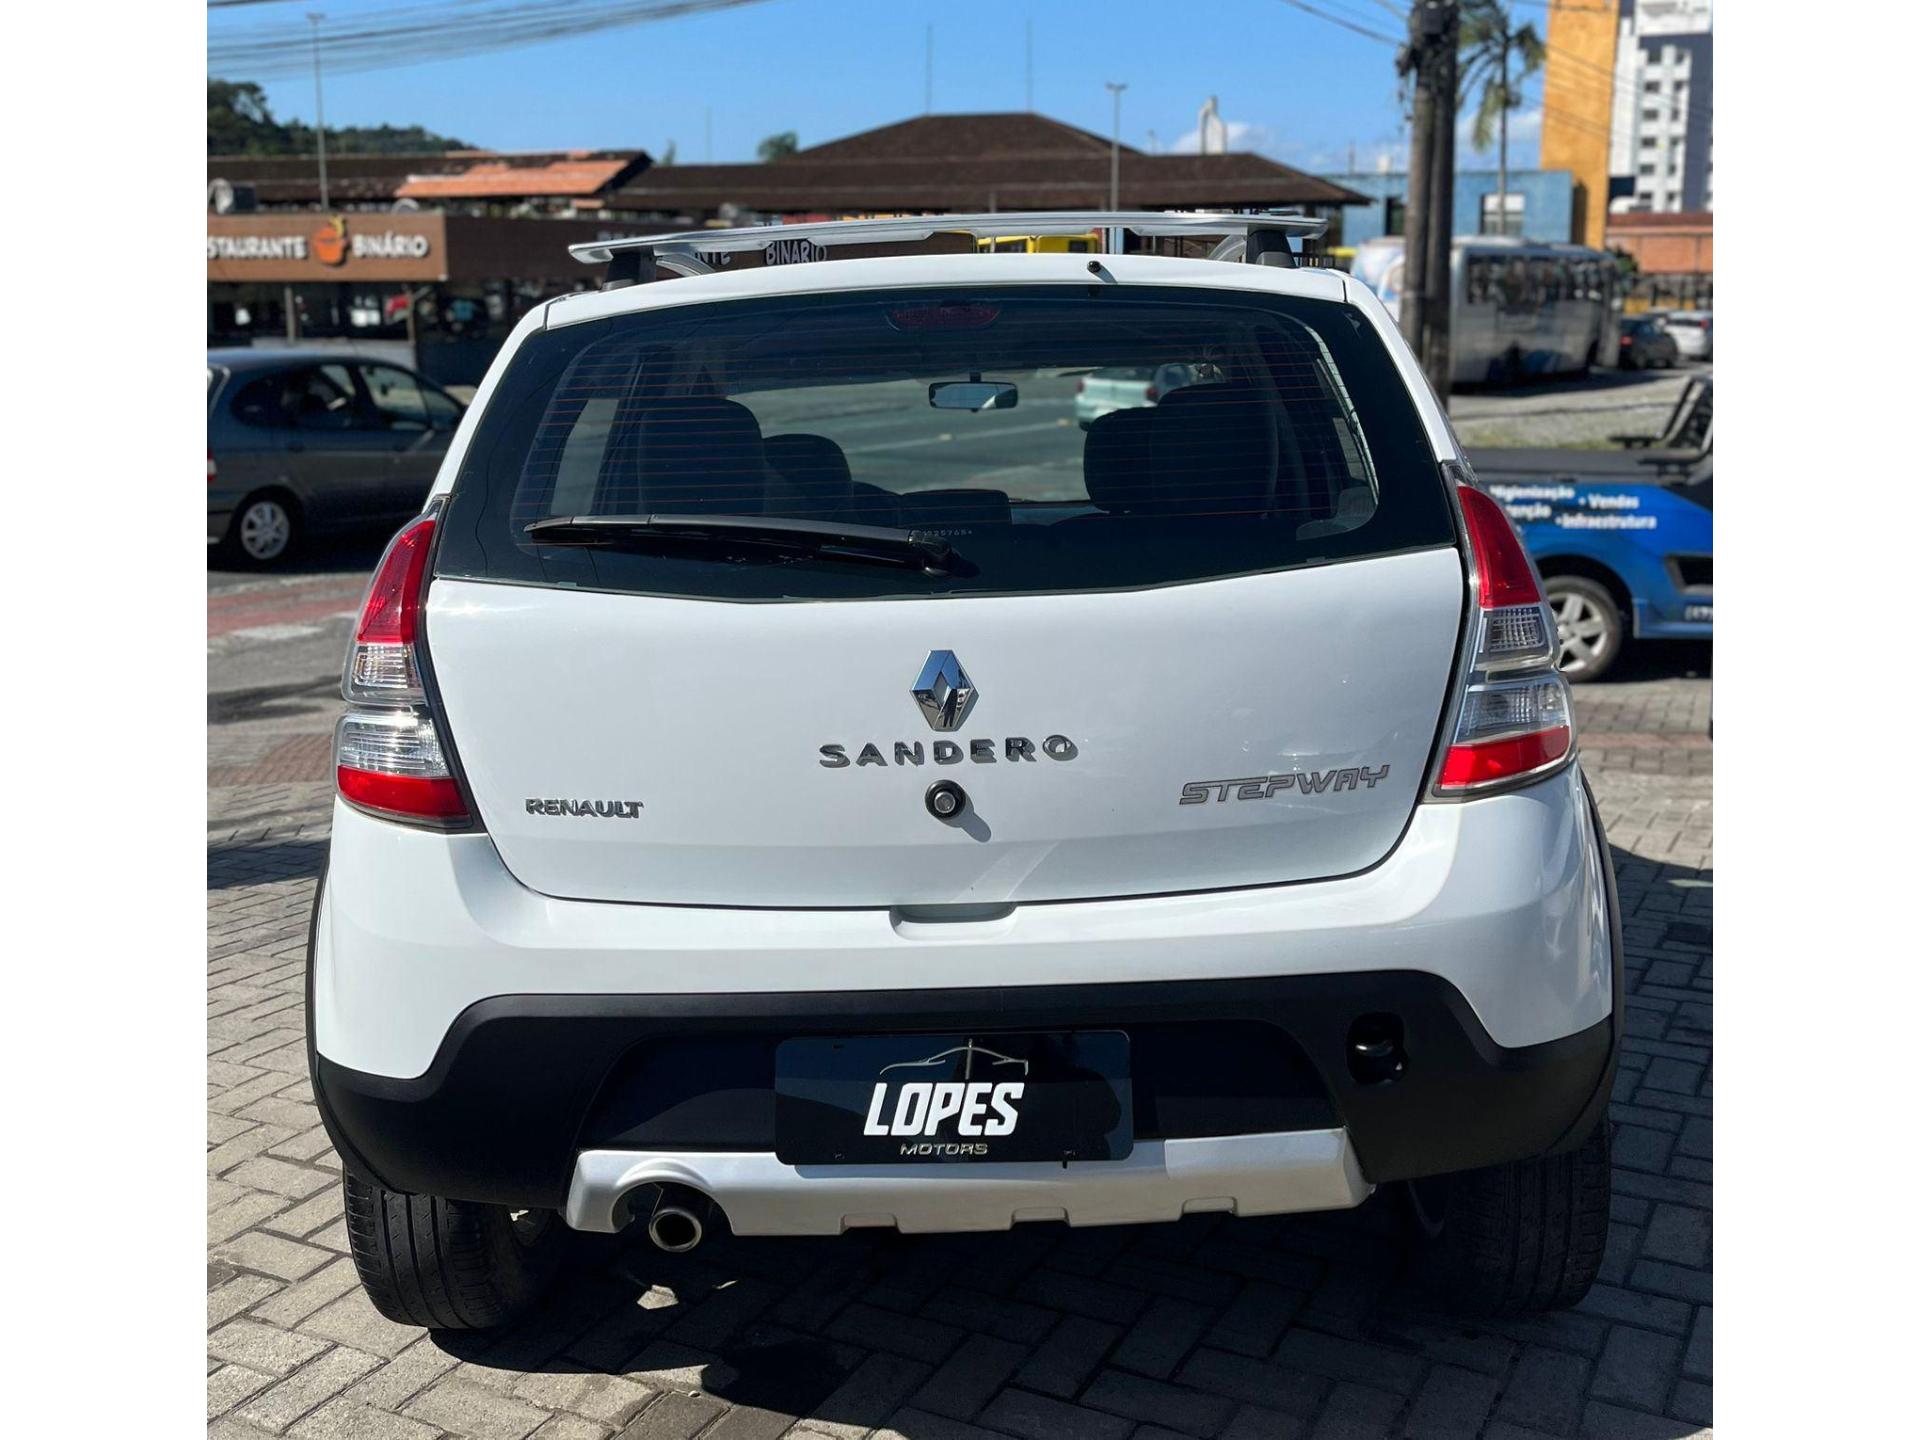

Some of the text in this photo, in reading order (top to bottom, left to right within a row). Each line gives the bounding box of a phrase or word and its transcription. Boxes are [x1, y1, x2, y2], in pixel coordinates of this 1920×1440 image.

[352, 231, 428, 258] BINÁRIO
[1588, 494, 1640, 510] Vendas
[1562, 513, 1658, 530] Infraestrutura
[819, 734, 1079, 768] SANDERO
[1179, 765, 1390, 805] STEPWAY
[525, 798, 644, 819] RENAULT
[863, 1082, 1025, 1136] LOPES
[900, 1143, 988, 1156] MOTORS
